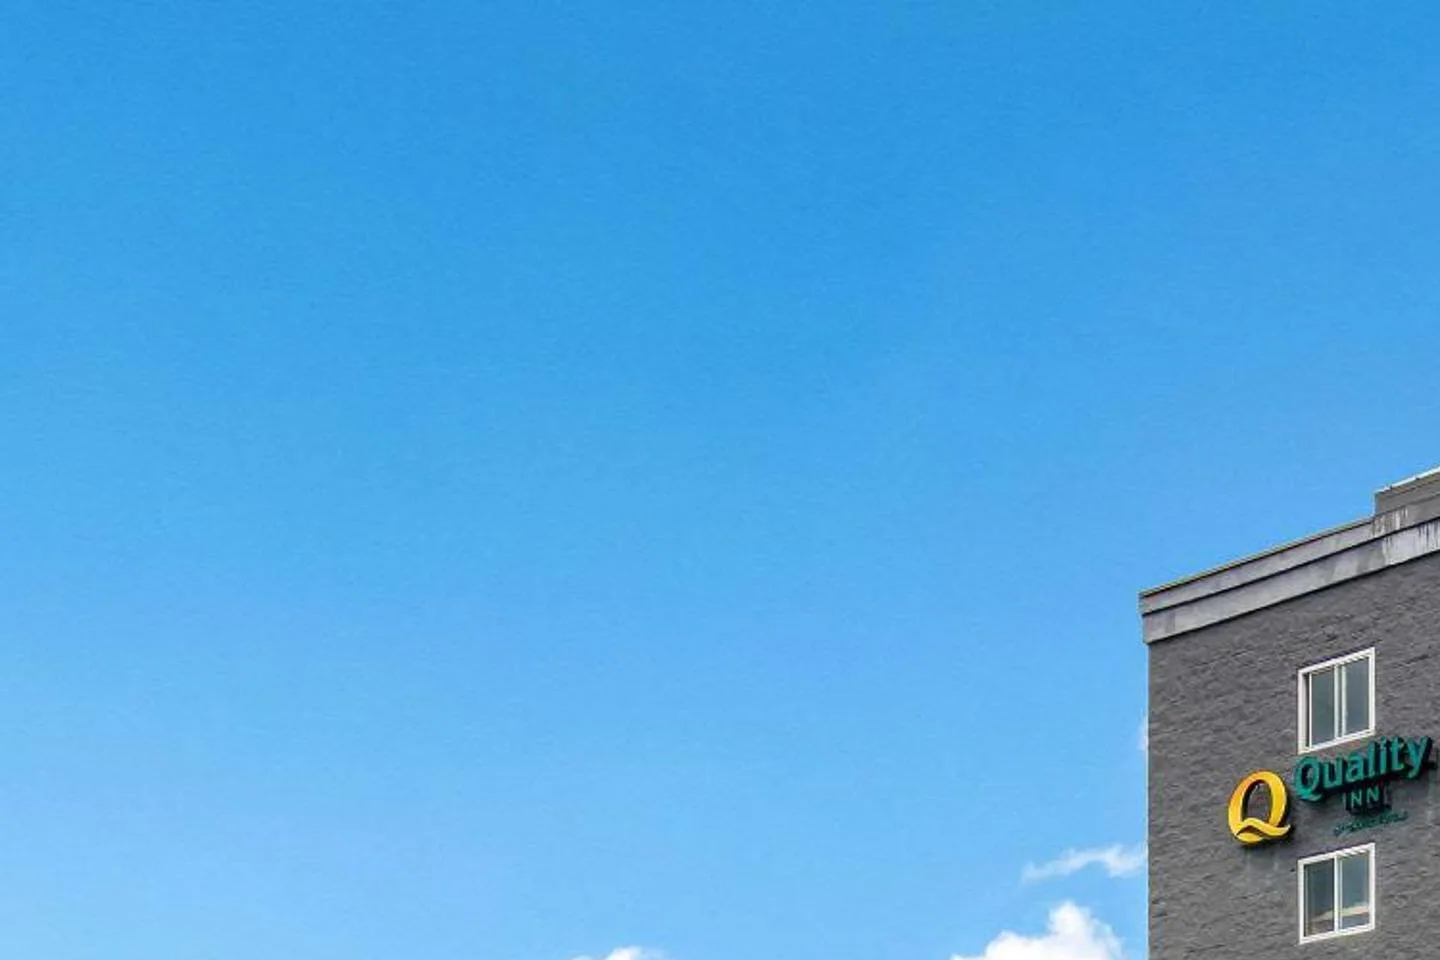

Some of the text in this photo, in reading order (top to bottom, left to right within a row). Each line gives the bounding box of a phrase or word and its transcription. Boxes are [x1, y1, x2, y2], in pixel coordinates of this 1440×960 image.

[1295, 735, 1431, 801] Quality
[1342, 784, 1381, 810] INN
[1228, 769, 1291, 844] Q
